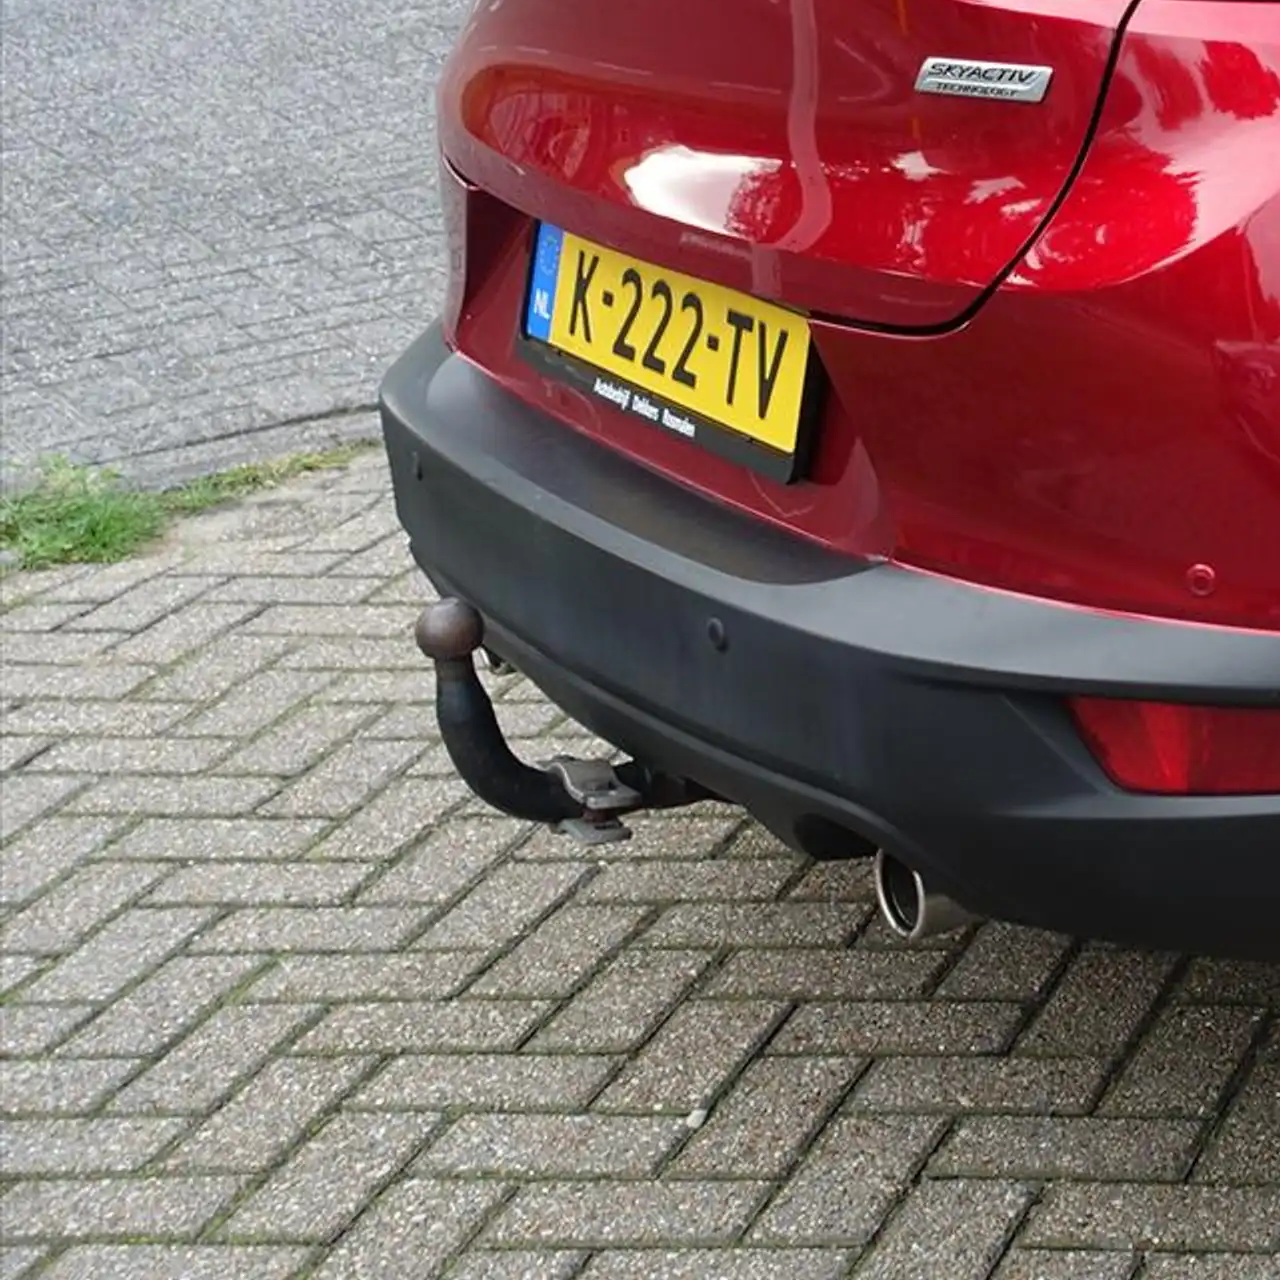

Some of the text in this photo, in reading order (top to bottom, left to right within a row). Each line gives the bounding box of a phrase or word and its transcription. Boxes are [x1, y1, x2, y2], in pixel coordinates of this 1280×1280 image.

[928, 62, 1036, 83] SKYACTIV
[936, 82, 1018, 97] TECHNOLOGY
[534, 289, 551, 321] NL
[570, 250, 789, 419] K-222-TV
